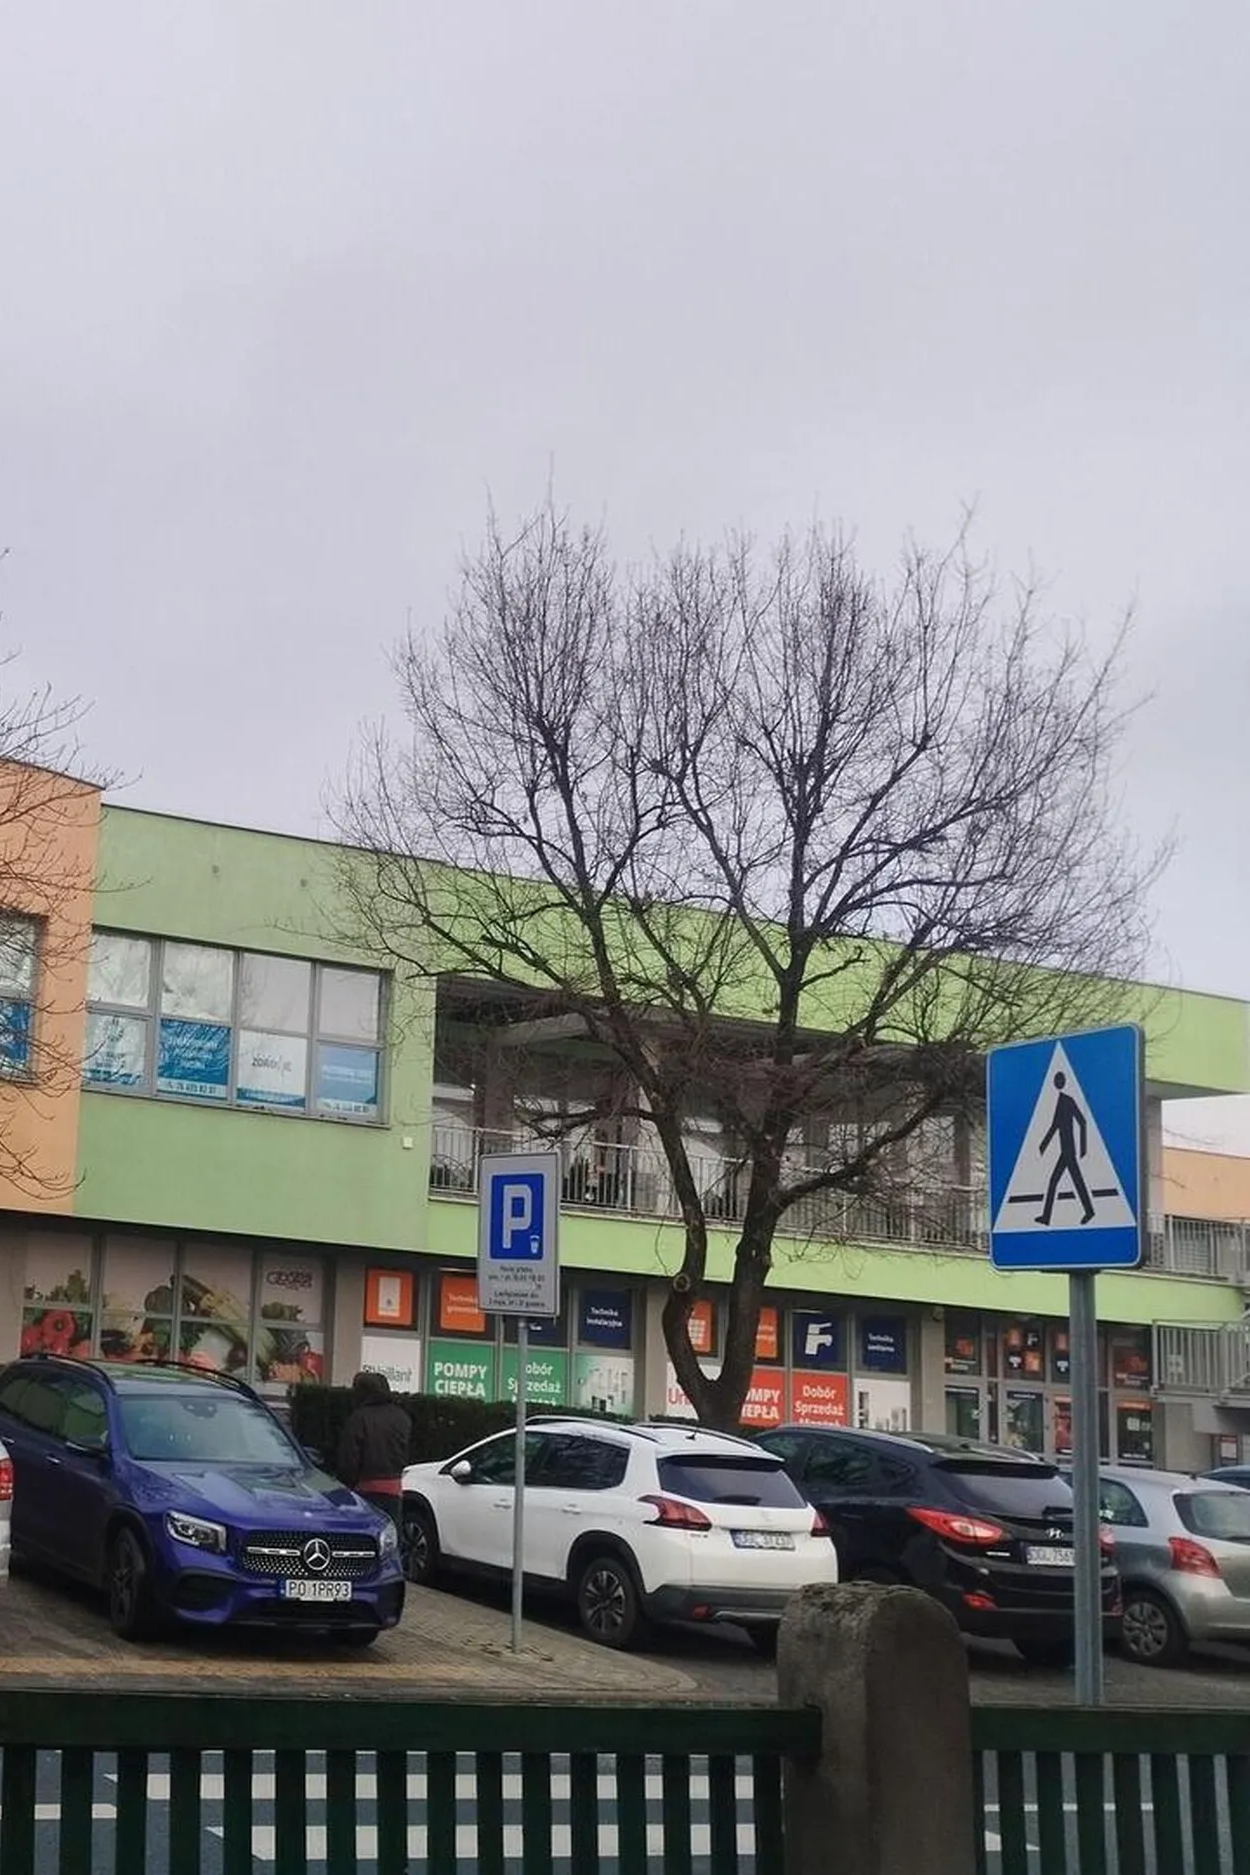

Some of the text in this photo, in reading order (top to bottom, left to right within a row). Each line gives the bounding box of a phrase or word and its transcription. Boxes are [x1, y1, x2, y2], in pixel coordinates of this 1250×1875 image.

[502, 1184, 532, 1249] P
[434, 1362, 487, 1379] POMPY
[525, 1362, 553, 1375] obór
[435, 1379, 486, 1397] CIEPŁA
[745, 1388, 780, 1404] MPY
[802, 1385, 836, 1399] Dobór
[741, 1403, 779, 1419] IEPŁA
[794, 1401, 844, 1417] Sprzedaż
[289, 1581, 349, 1597] PO 1PR93
